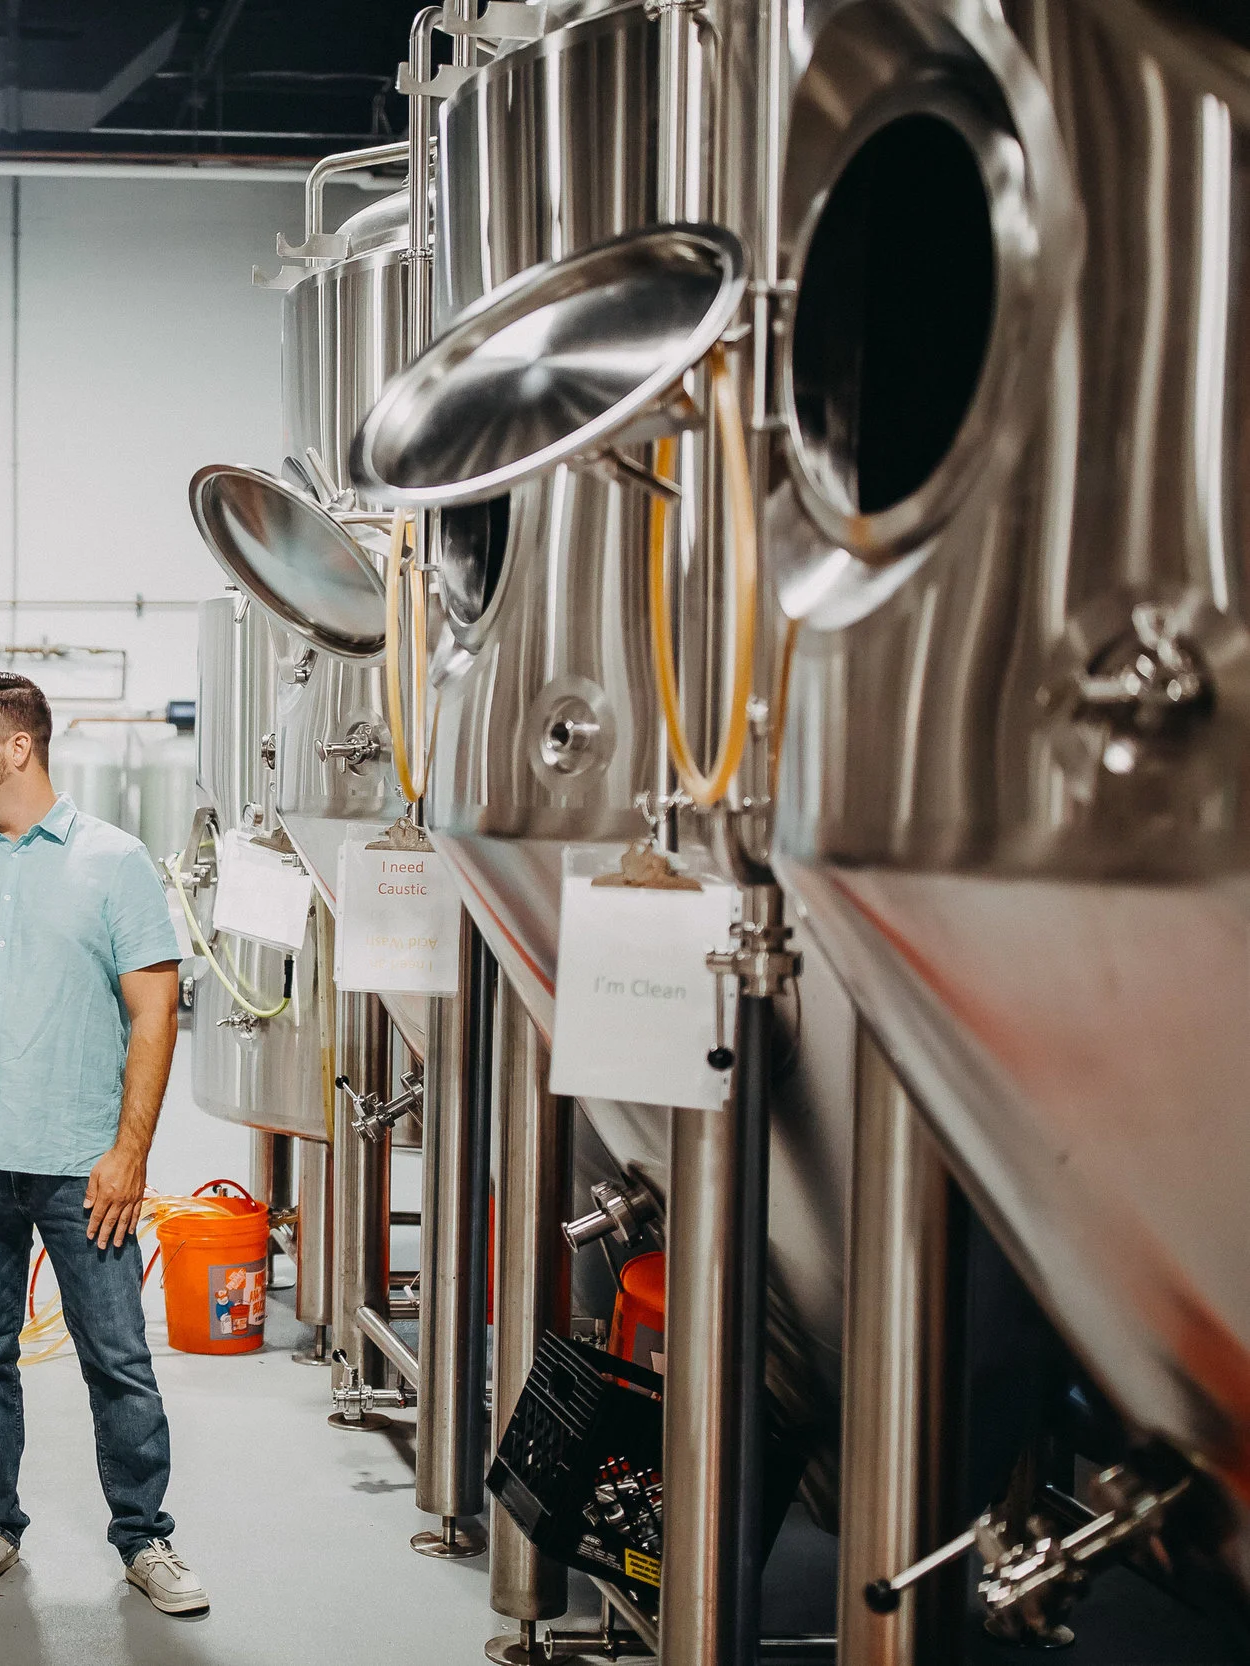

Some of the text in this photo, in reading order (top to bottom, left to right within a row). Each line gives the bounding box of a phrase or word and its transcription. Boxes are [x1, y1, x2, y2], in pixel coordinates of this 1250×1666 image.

[382, 861, 424, 873] I need
[378, 882, 427, 896] Caustic
[593, 976, 687, 1000] I'm Clean
